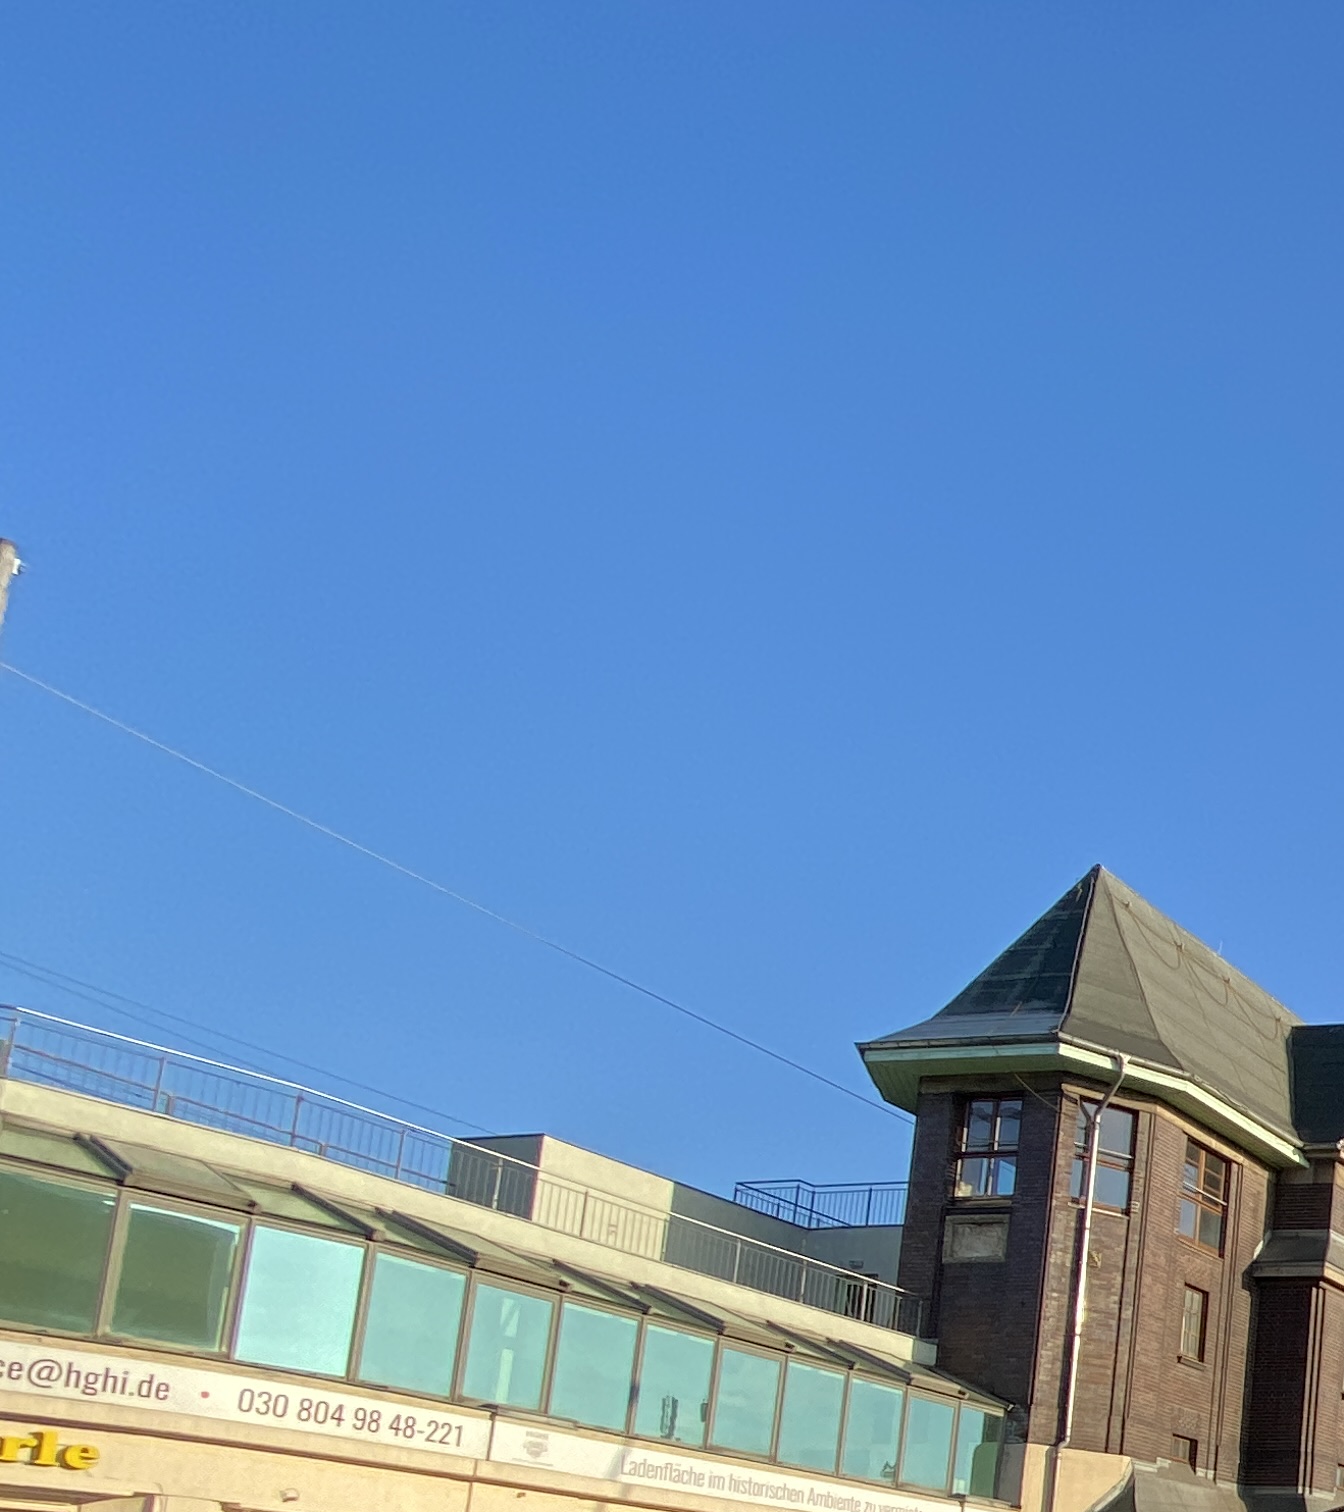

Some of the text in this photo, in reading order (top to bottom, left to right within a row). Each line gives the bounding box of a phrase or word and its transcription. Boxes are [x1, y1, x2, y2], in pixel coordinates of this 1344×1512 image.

[238, 1388, 289, 1418] 030
[297, 1398, 345, 1427] 804
[352, 1407, 382, 1433] 98
[388, 1413, 464, 1448] 48-221
[620, 1455, 706, 1488] Ladenfläche
[708, 1470, 726, 1492] im
[728, 1474, 805, 1504] historischen
